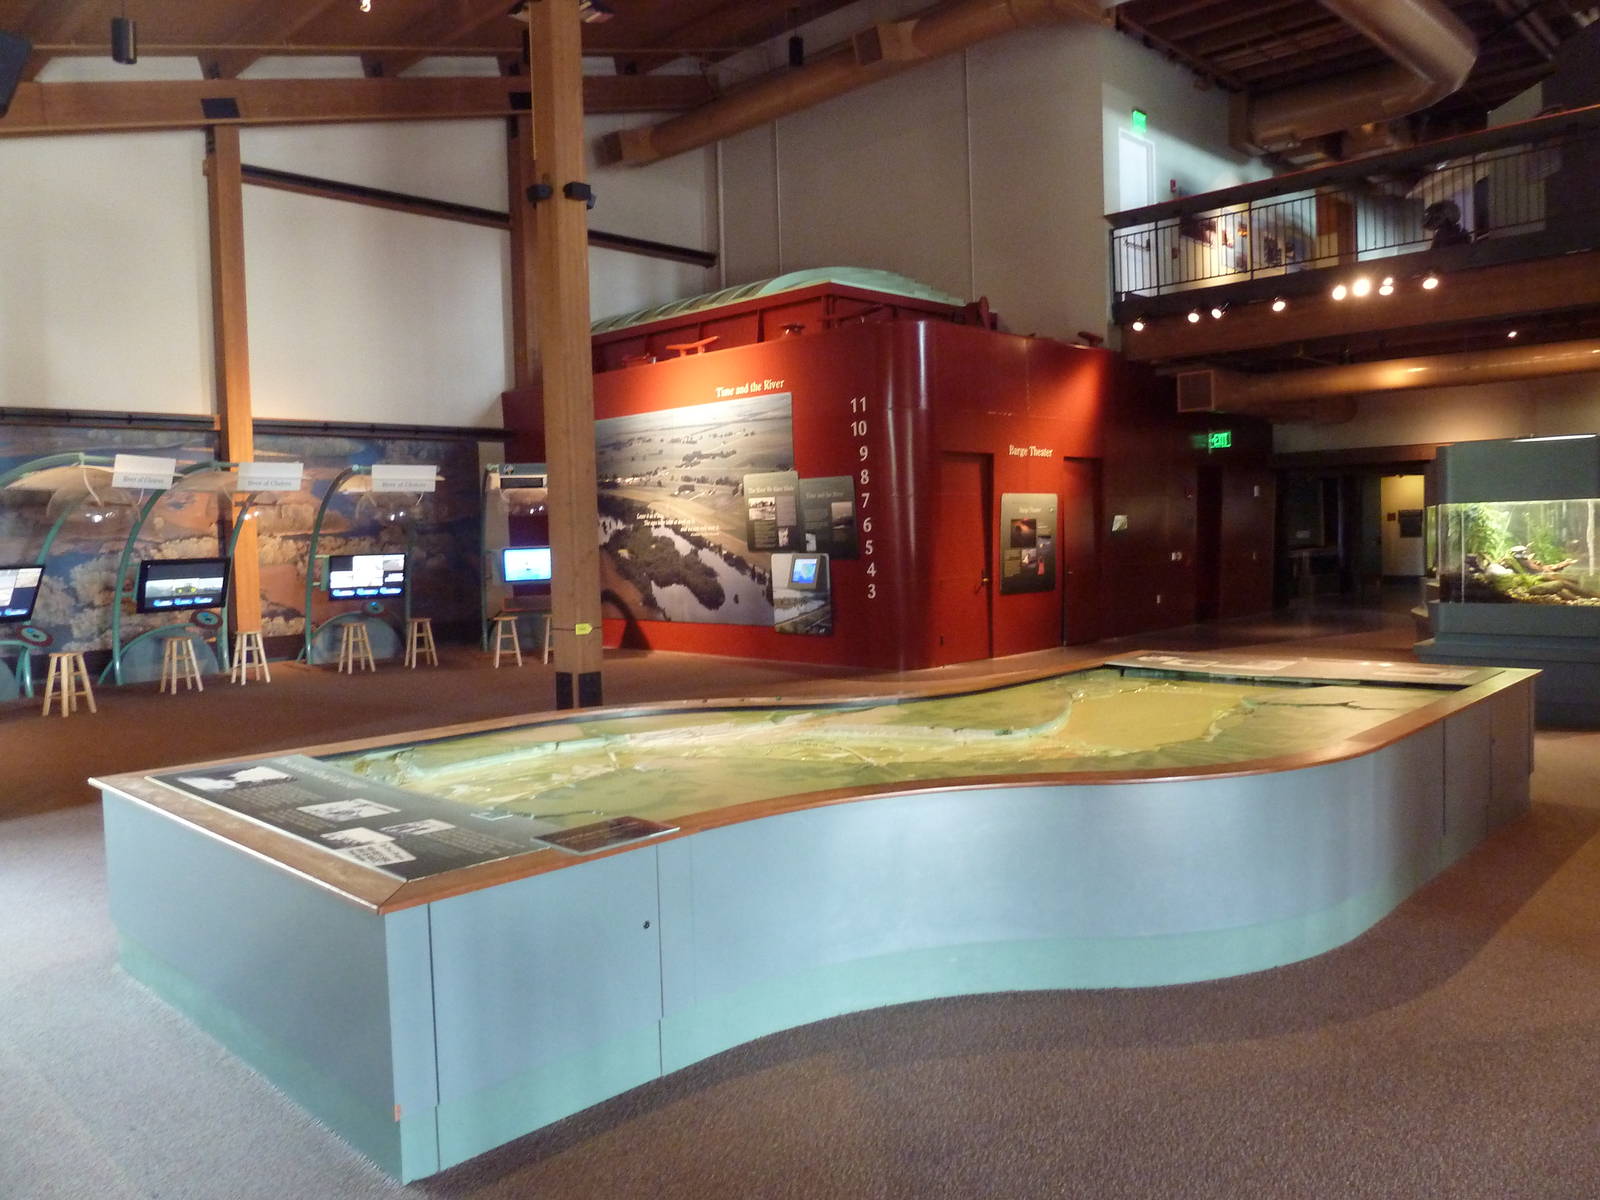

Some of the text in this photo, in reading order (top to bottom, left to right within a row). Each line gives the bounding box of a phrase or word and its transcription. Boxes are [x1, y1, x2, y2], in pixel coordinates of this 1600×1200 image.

[715, 379, 785, 398] Time and the River
[850, 396, 867, 413] 11
[850, 420, 867, 437] 10
[859, 445, 868, 462] 9
[1008, 444, 1053, 458] Barge Theater
[860, 469, 869, 485] 8
[861, 492, 870, 509] 7
[862, 517, 872, 533] 6
[865, 540, 873, 555] 5
[866, 562, 877, 577] 4
[867, 583, 876, 599] 3
